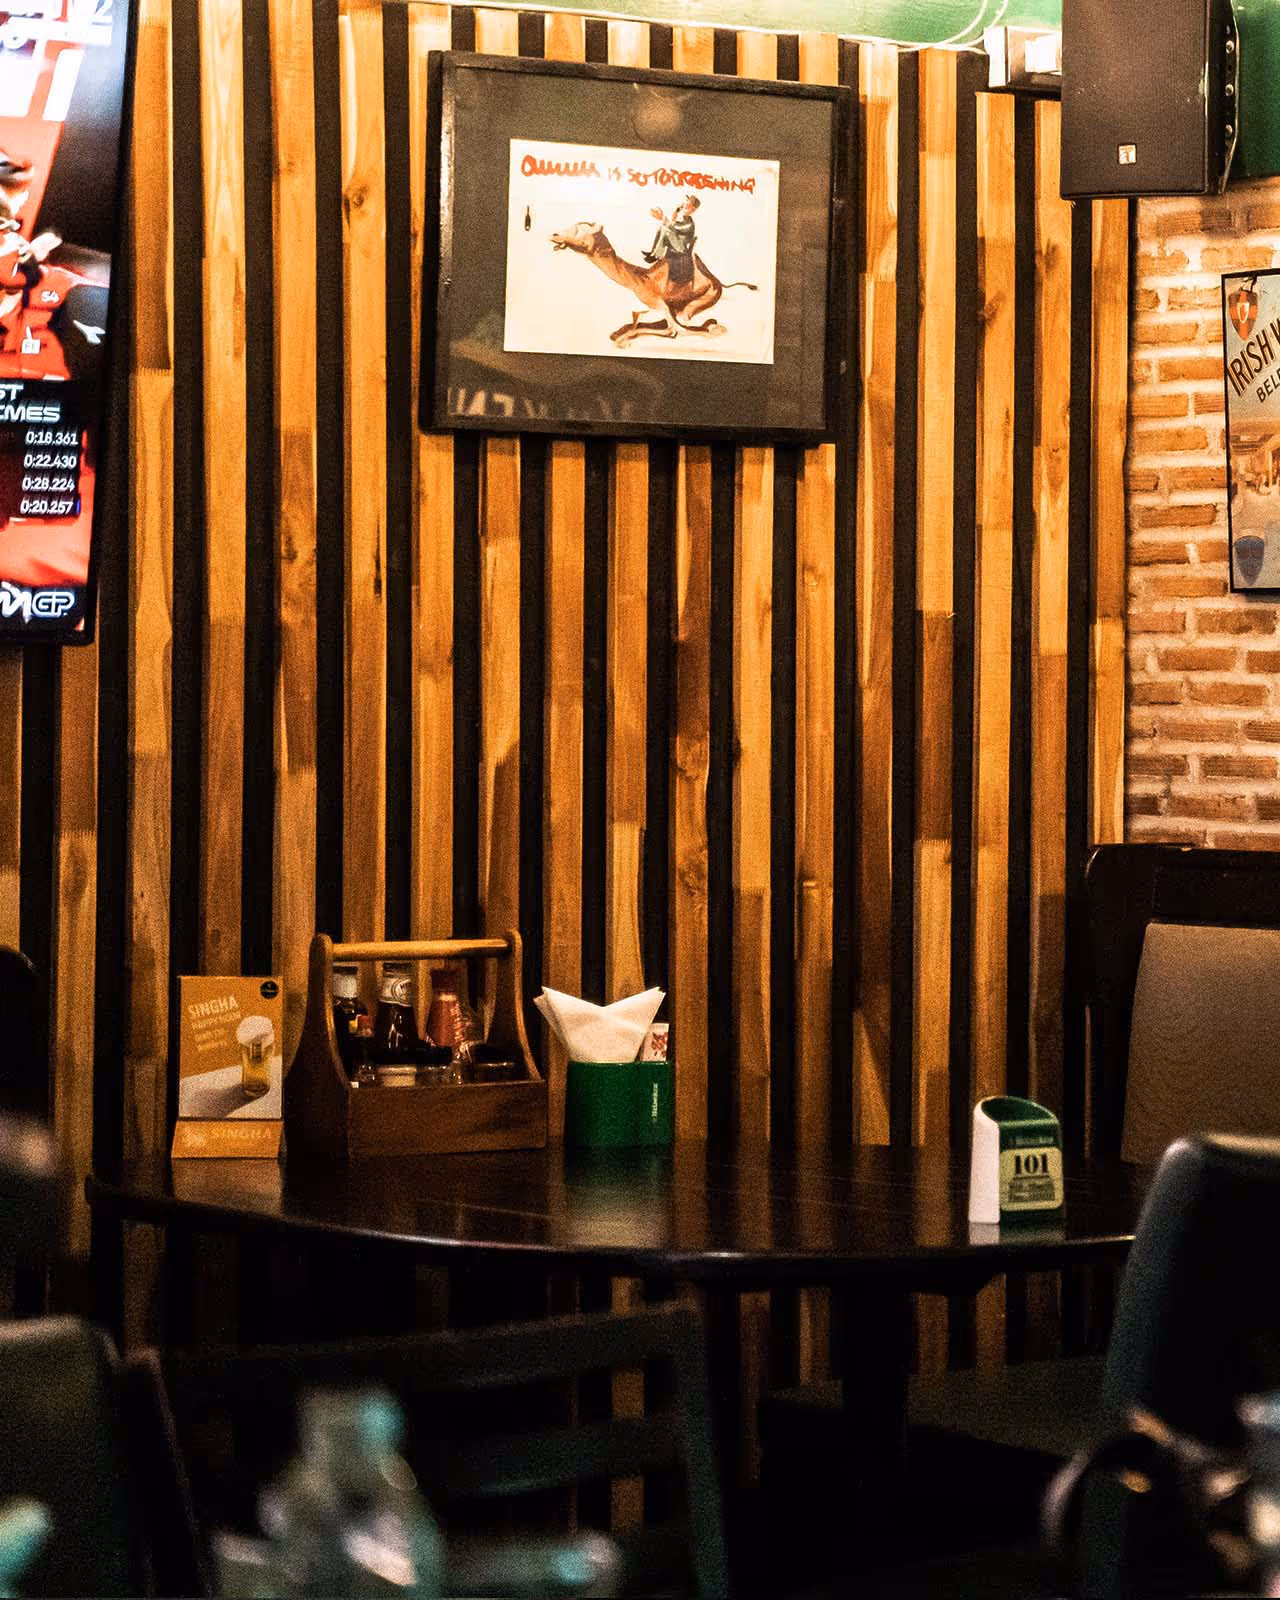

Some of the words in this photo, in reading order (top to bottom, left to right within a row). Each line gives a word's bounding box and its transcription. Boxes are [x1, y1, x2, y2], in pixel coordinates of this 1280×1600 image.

[1226, 330, 1275, 397] IRISH
[187, 995, 239, 1019] SINGHA
[210, 1127, 272, 1139] SINGHA
[1014, 1153, 1049, 1176] 101
